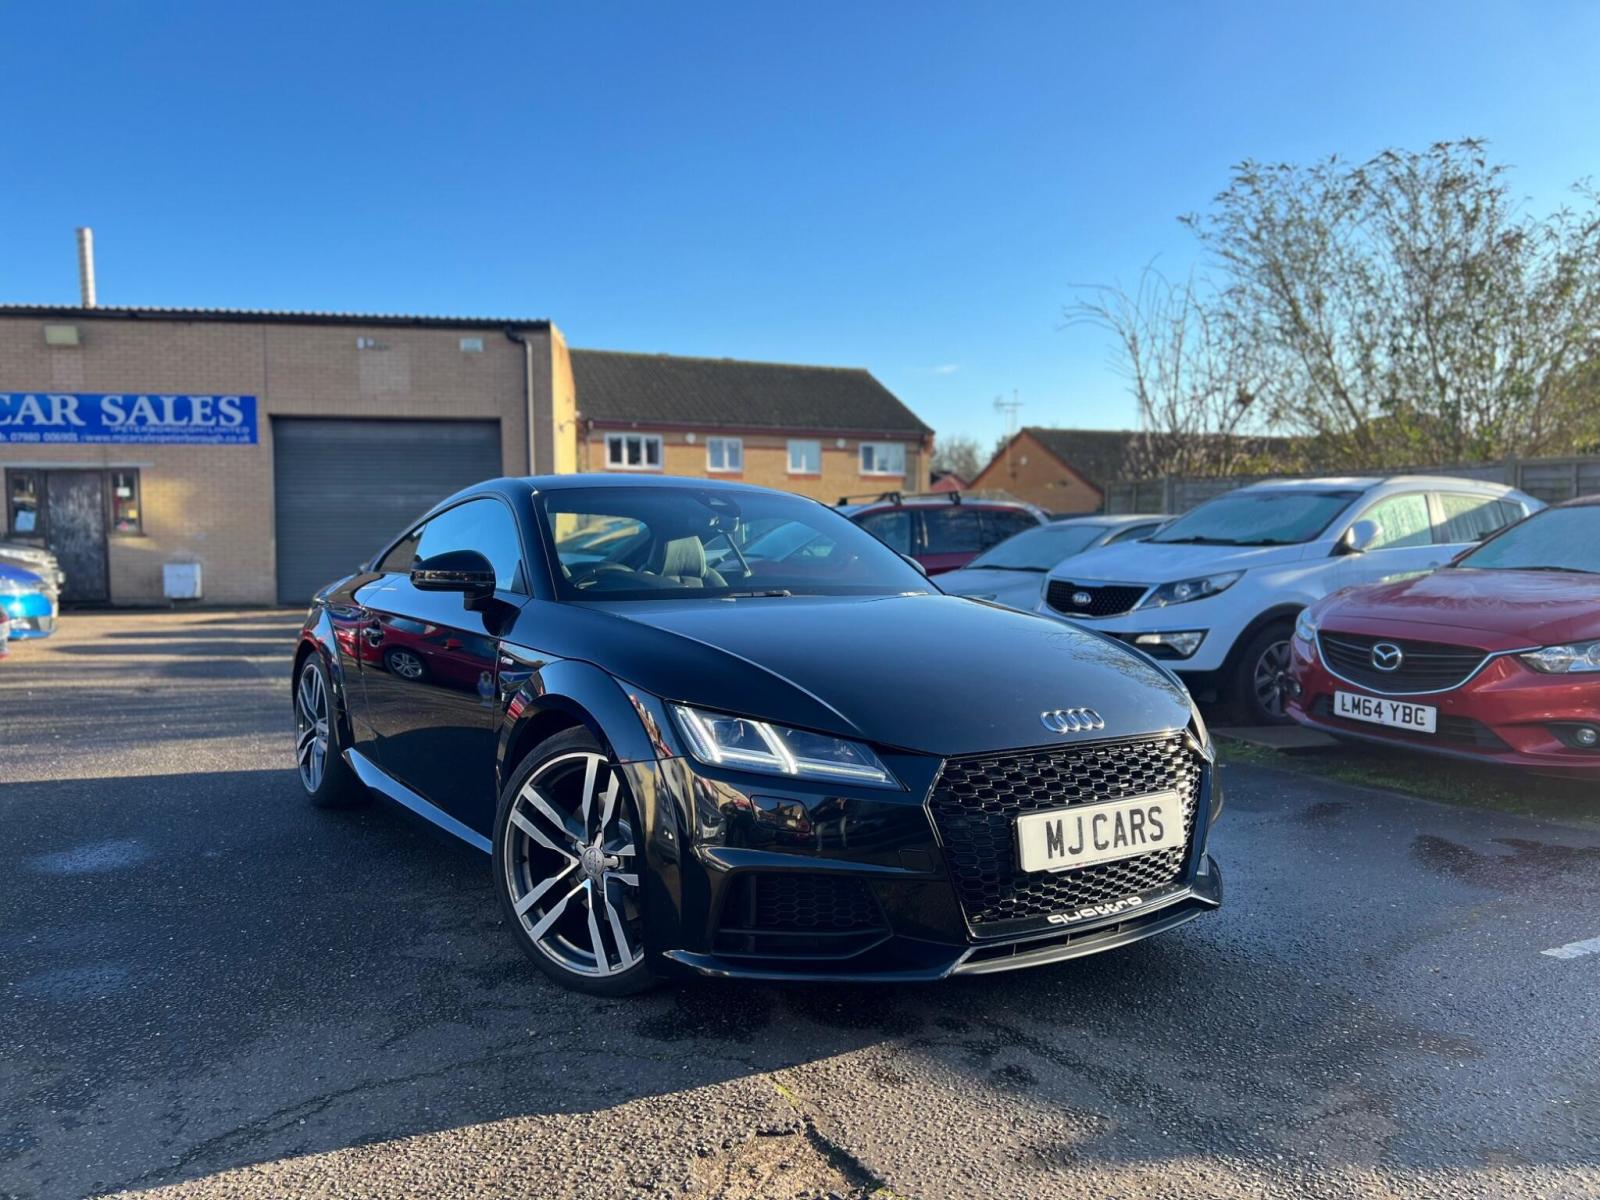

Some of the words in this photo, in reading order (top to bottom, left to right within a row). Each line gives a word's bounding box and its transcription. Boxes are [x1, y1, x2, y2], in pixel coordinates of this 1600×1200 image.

[101, 396, 244, 426] SALES
[1341, 695, 1383, 719] LM64
[1390, 703, 1426, 726] YBC
[1092, 806, 1164, 851] CARS
[1047, 896, 1143, 924] quattro
